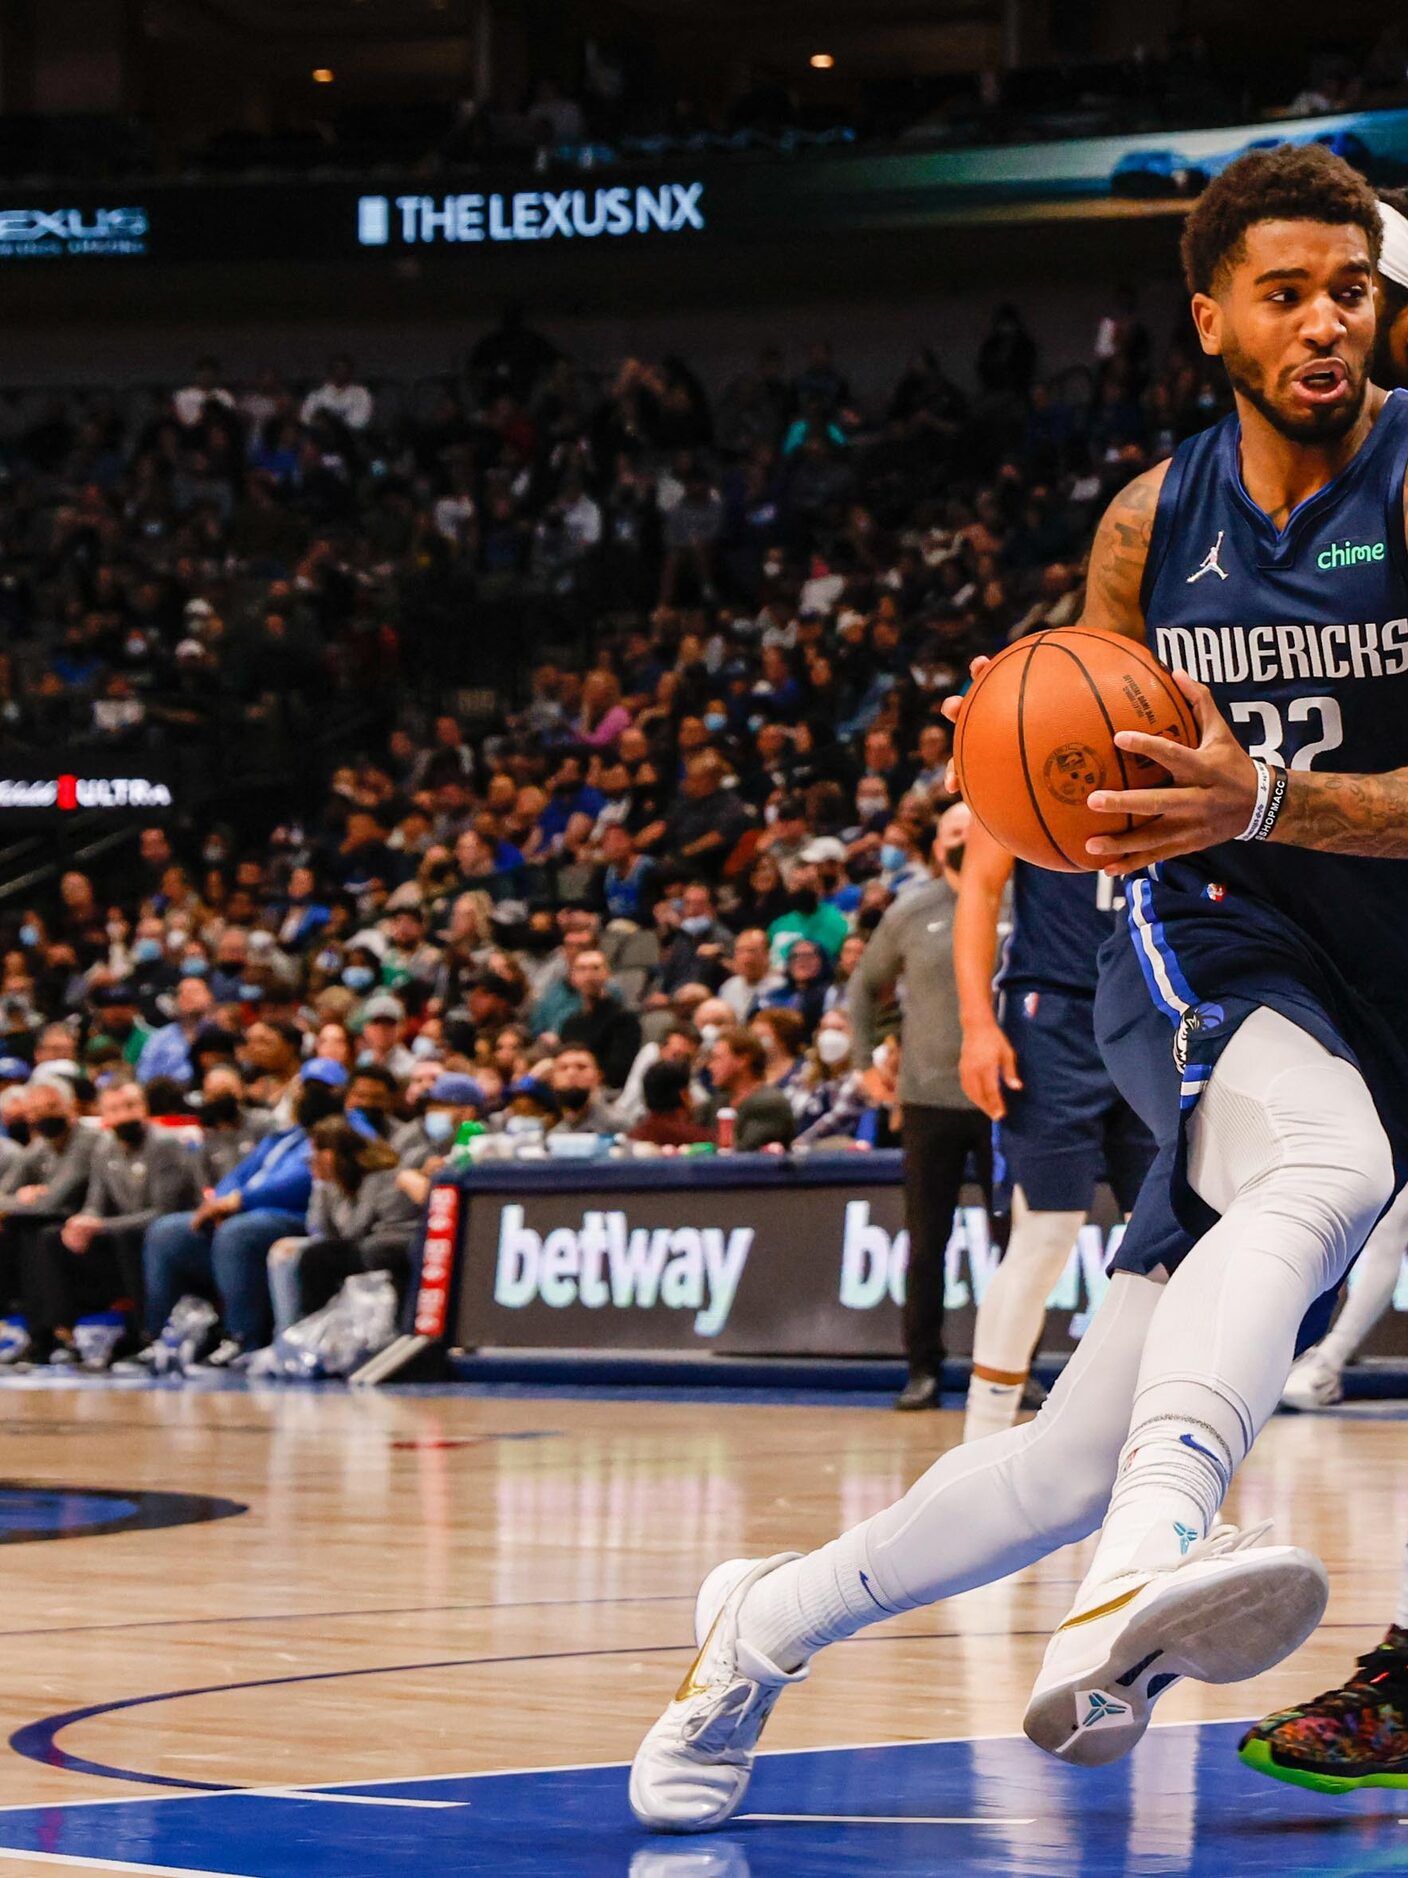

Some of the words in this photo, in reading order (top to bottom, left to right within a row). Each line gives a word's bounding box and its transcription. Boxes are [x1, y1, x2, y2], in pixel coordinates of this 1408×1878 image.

[396, 194, 485, 244] THE
[489, 187, 633, 241] LEXUS
[636, 182, 704, 233] NX
[1317, 541, 1385, 570] chime
[1229, 696, 1344, 772] 32
[494, 1204, 755, 1338] betway
